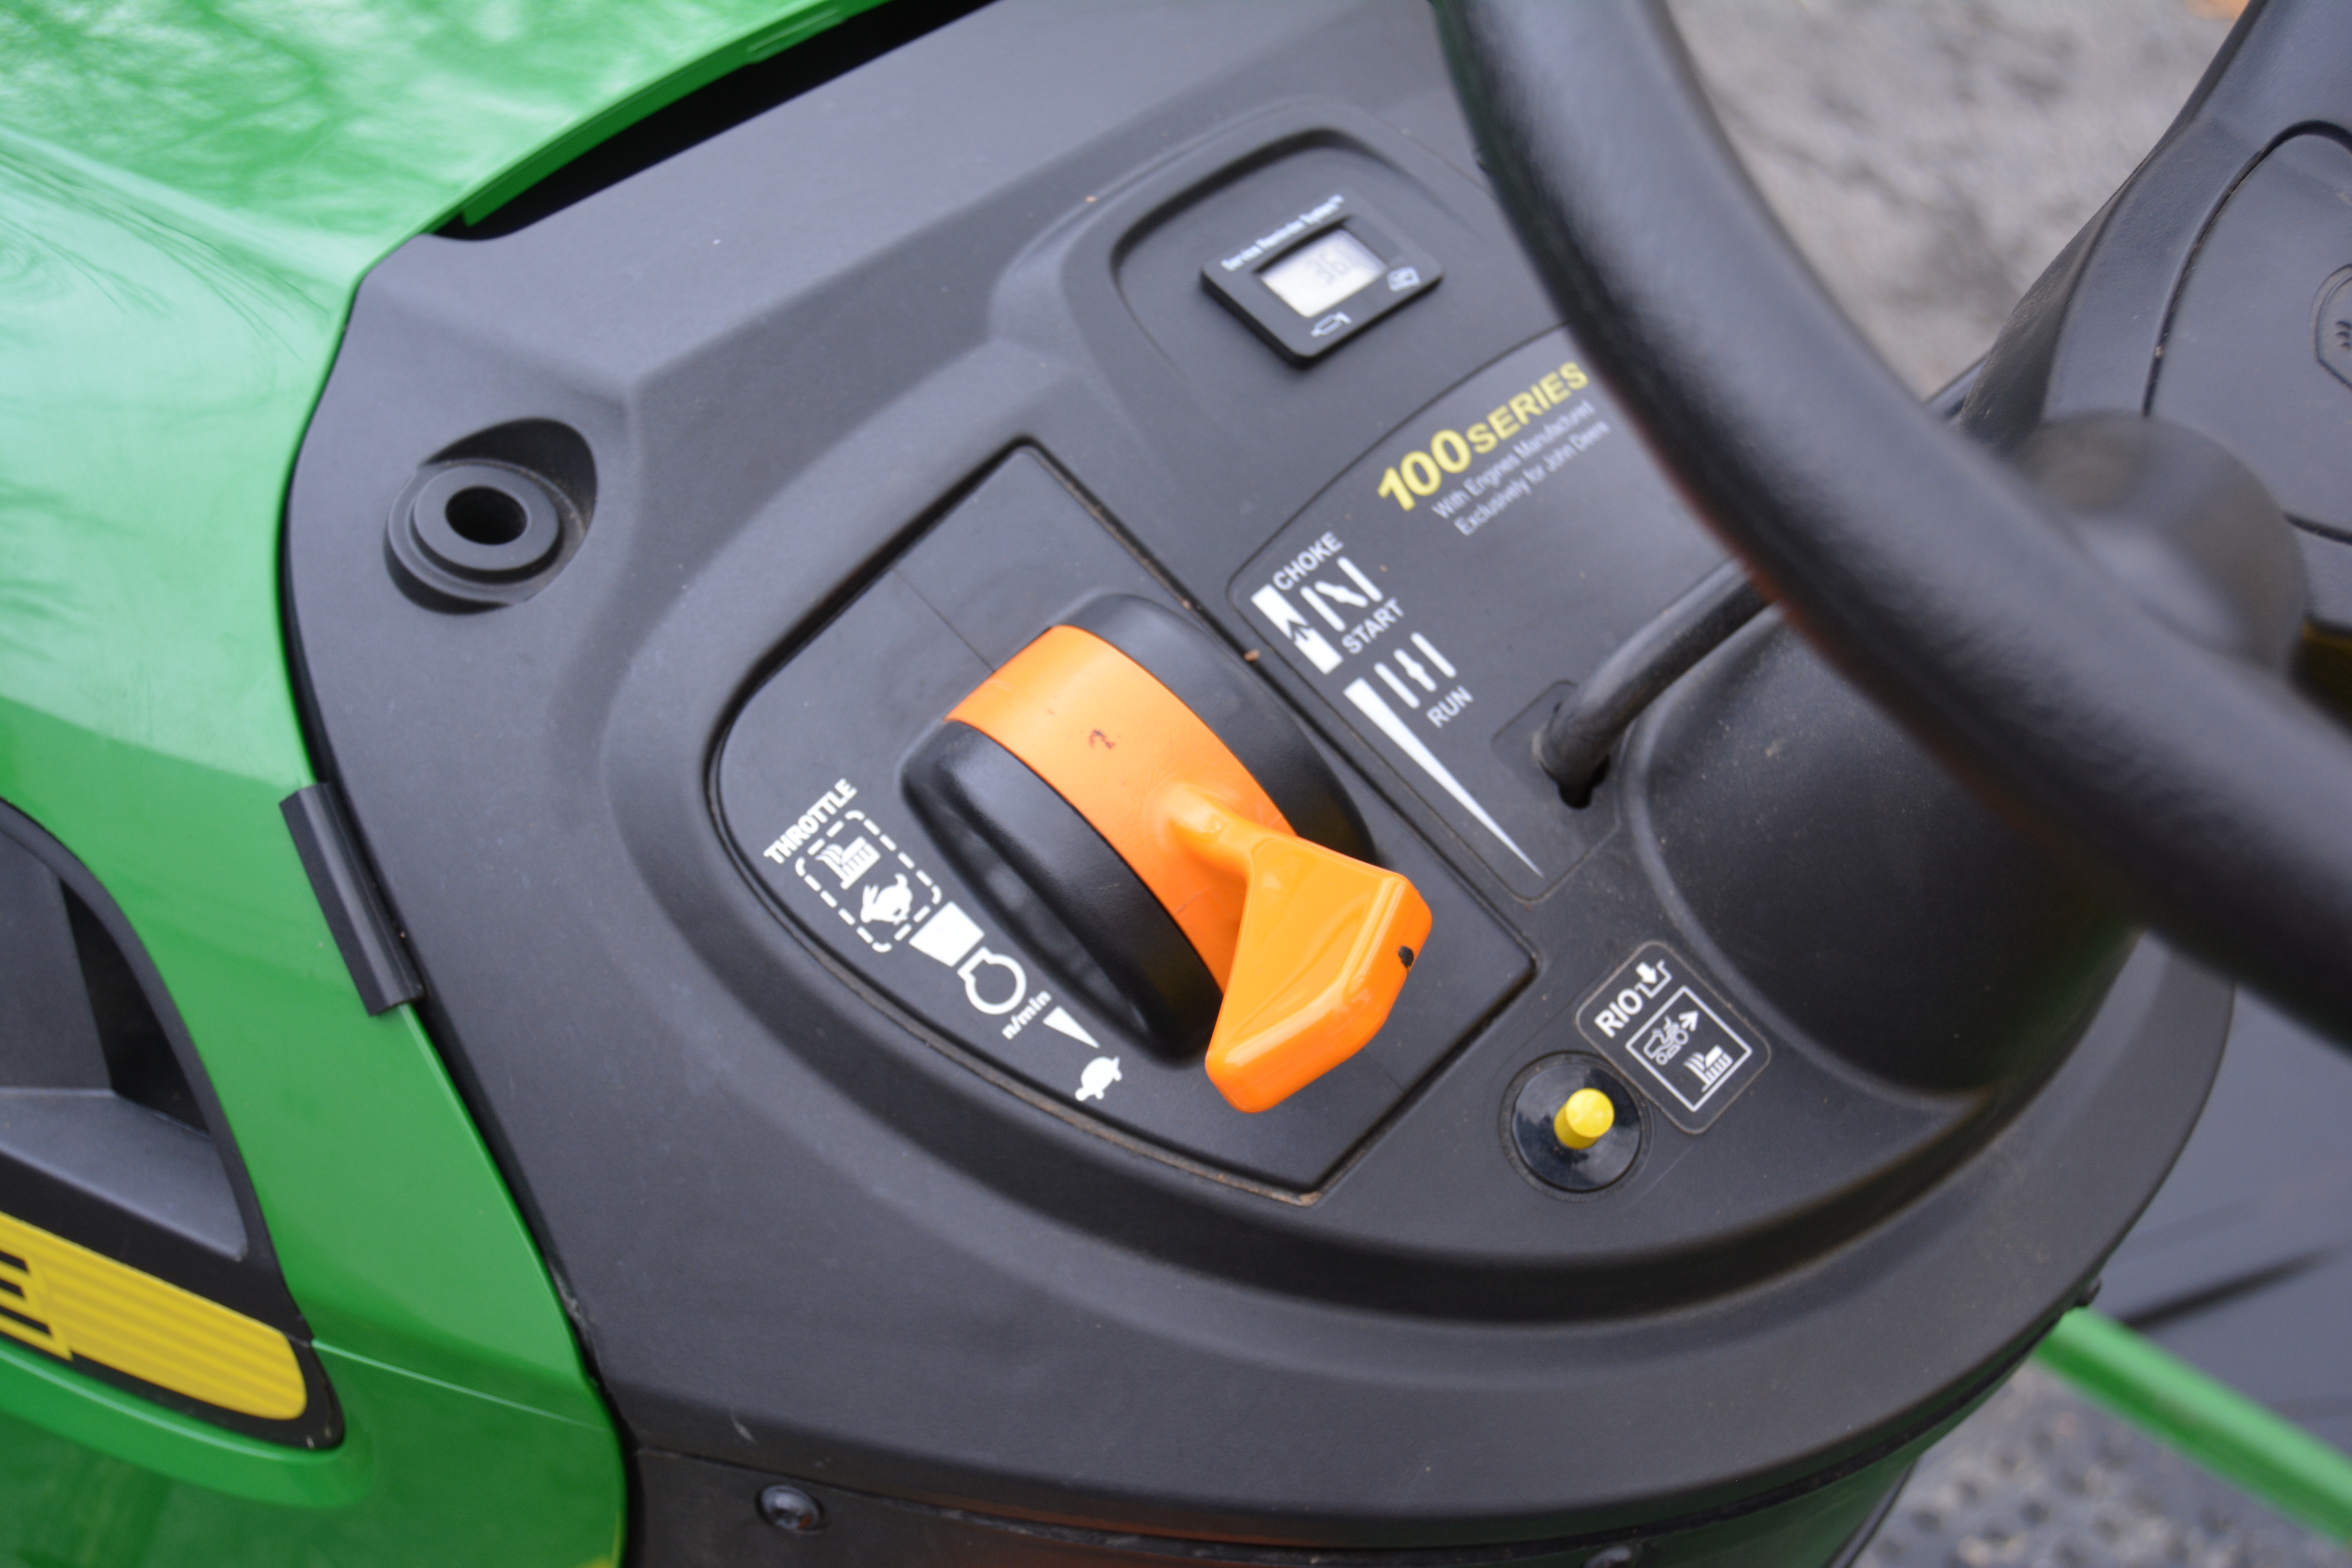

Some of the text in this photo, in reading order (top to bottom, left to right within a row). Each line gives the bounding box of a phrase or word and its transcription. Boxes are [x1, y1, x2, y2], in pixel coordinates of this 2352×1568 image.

[1377, 361, 1590, 511] 100 SERIES
[1431, 489, 1471, 519] With
[1463, 452, 1521, 497] Engines
[1453, 421, 1610, 536] Exclusively for John Deere
[1272, 531, 1344, 590] CHOKE
[1341, 597, 1404, 654] START
[1426, 684, 1474, 728] RUN
[763, 778, 858, 864] THROTTLE
[1002, 990, 1052, 1040] n/min
[1593, 989, 1644, 1038] RIO
